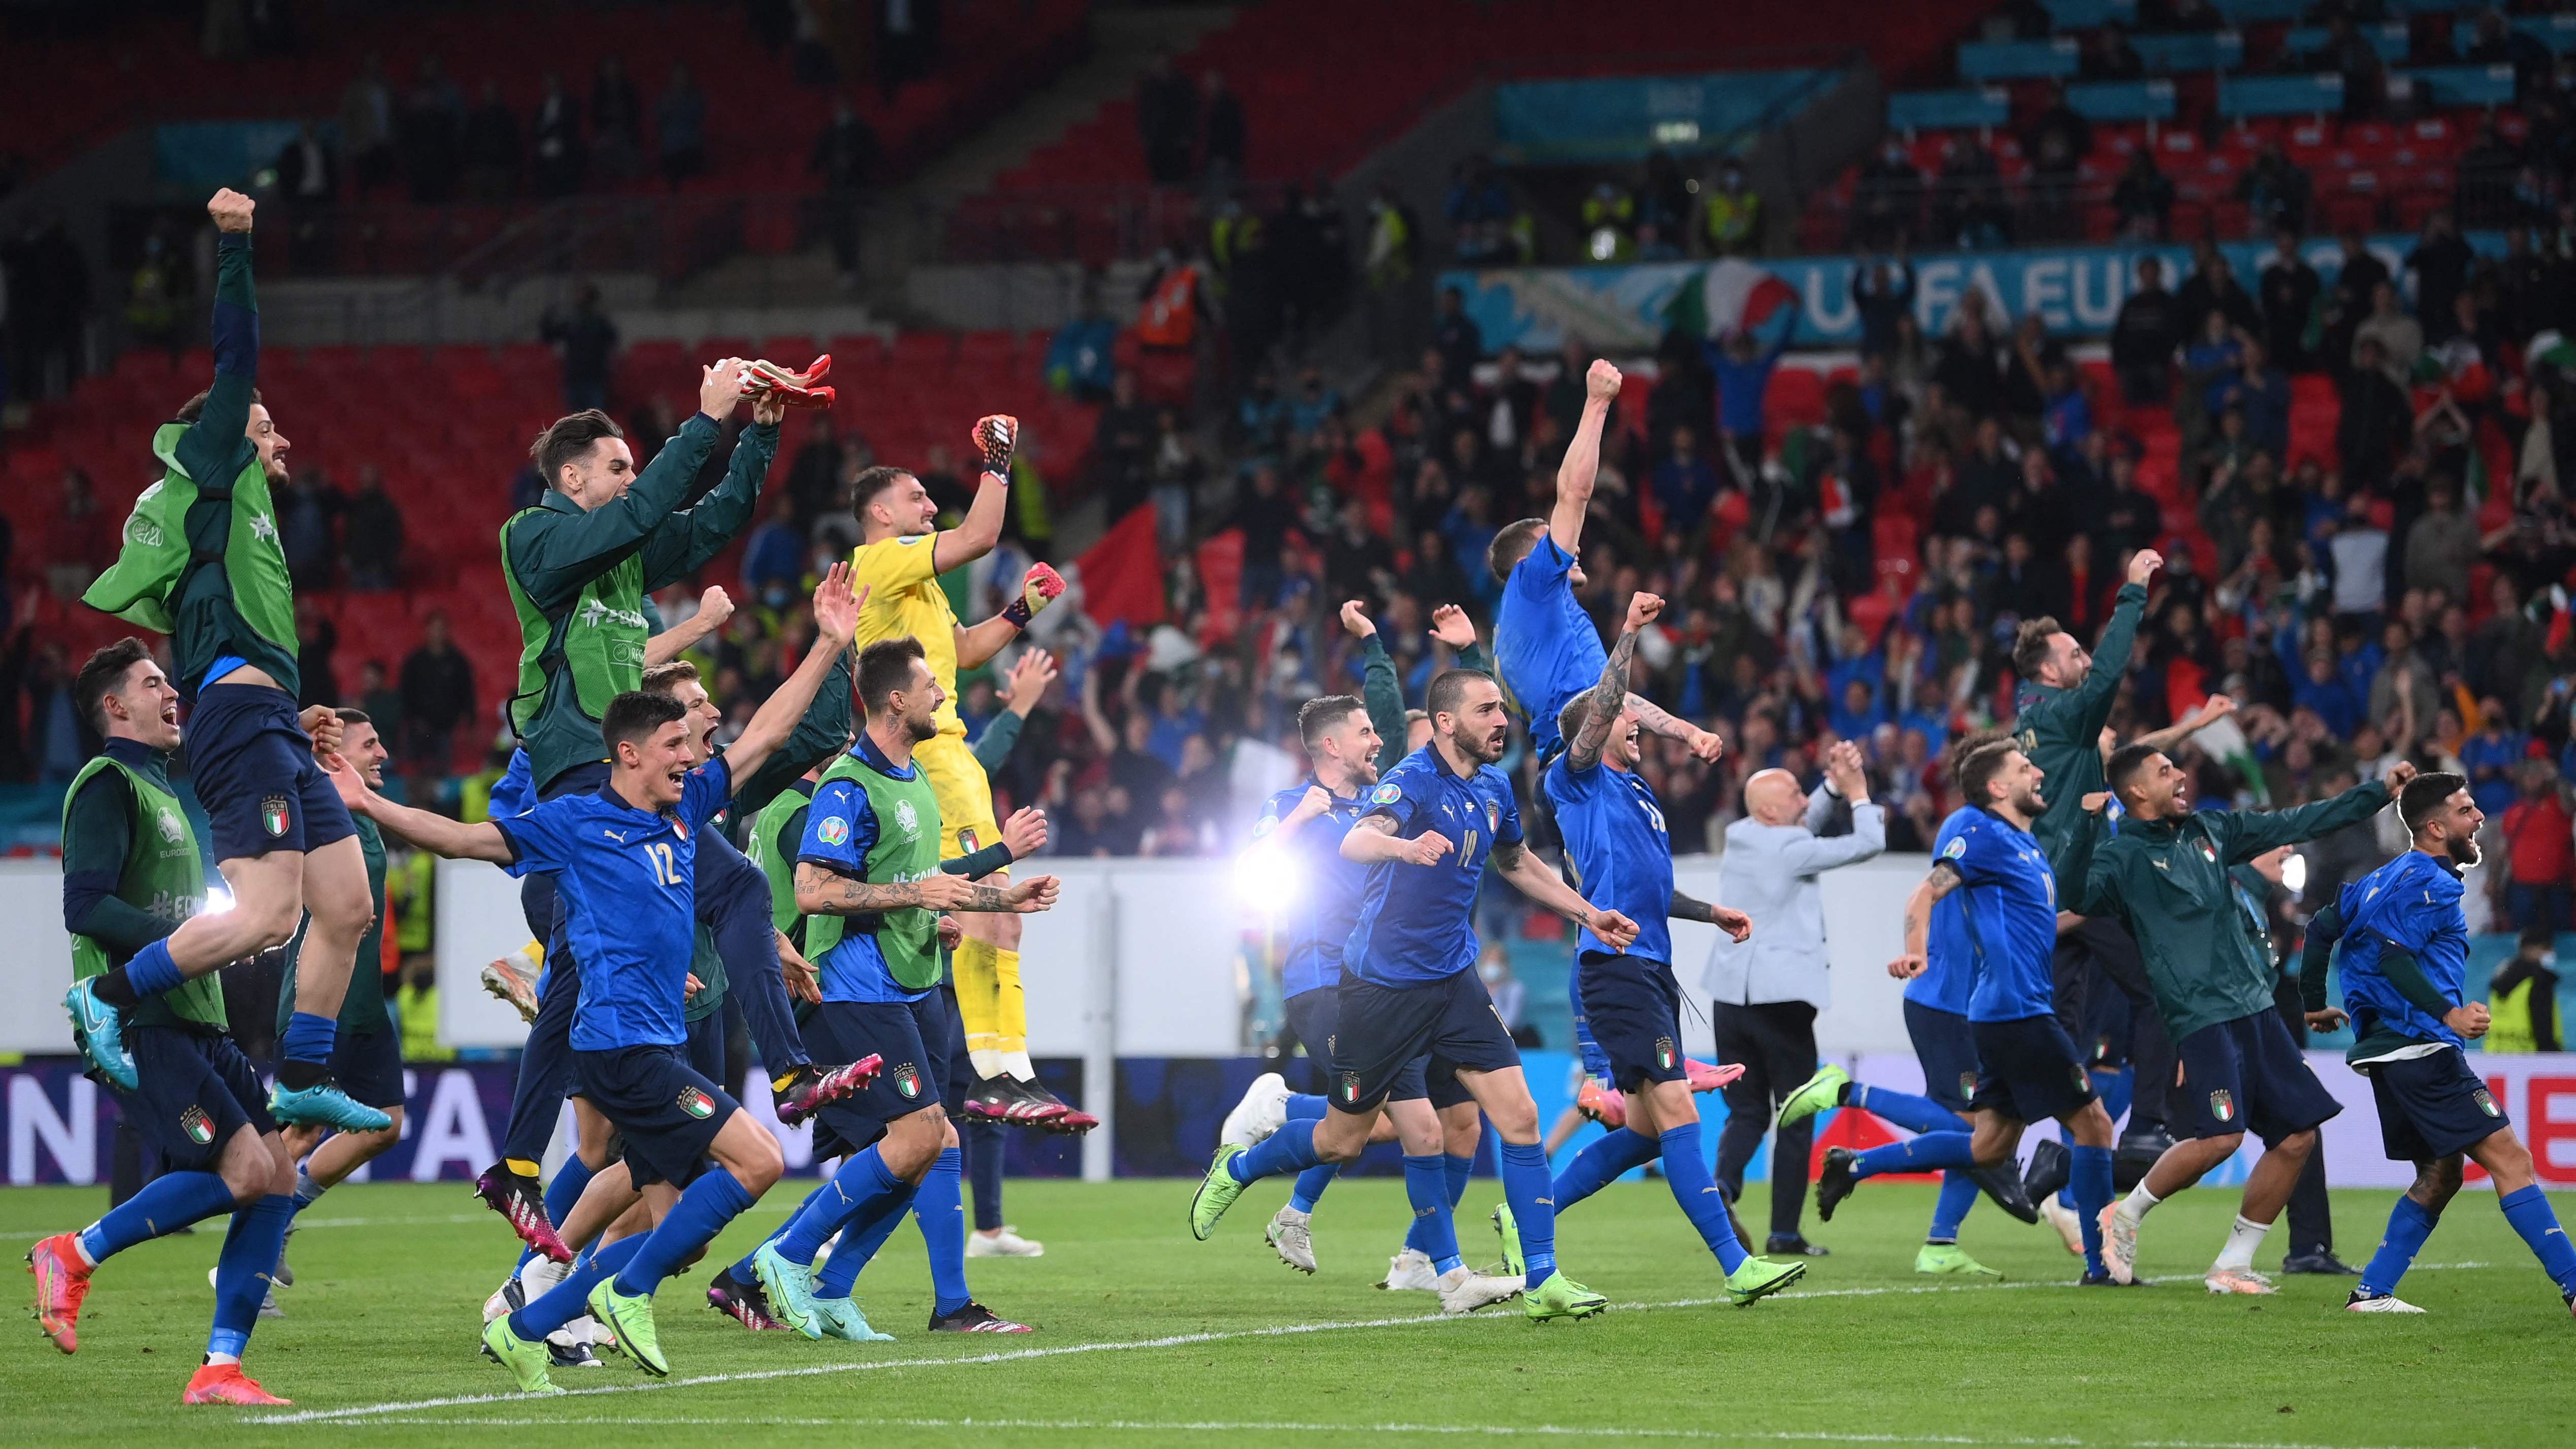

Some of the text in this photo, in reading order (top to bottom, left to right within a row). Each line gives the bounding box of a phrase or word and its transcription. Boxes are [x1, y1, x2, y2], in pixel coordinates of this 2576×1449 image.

[1804, 260, 2014, 335] UFA
[643, 842, 682, 885] 12
[1456, 830, 1478, 868] 19
[896, 1069, 915, 1079] ITALIA
